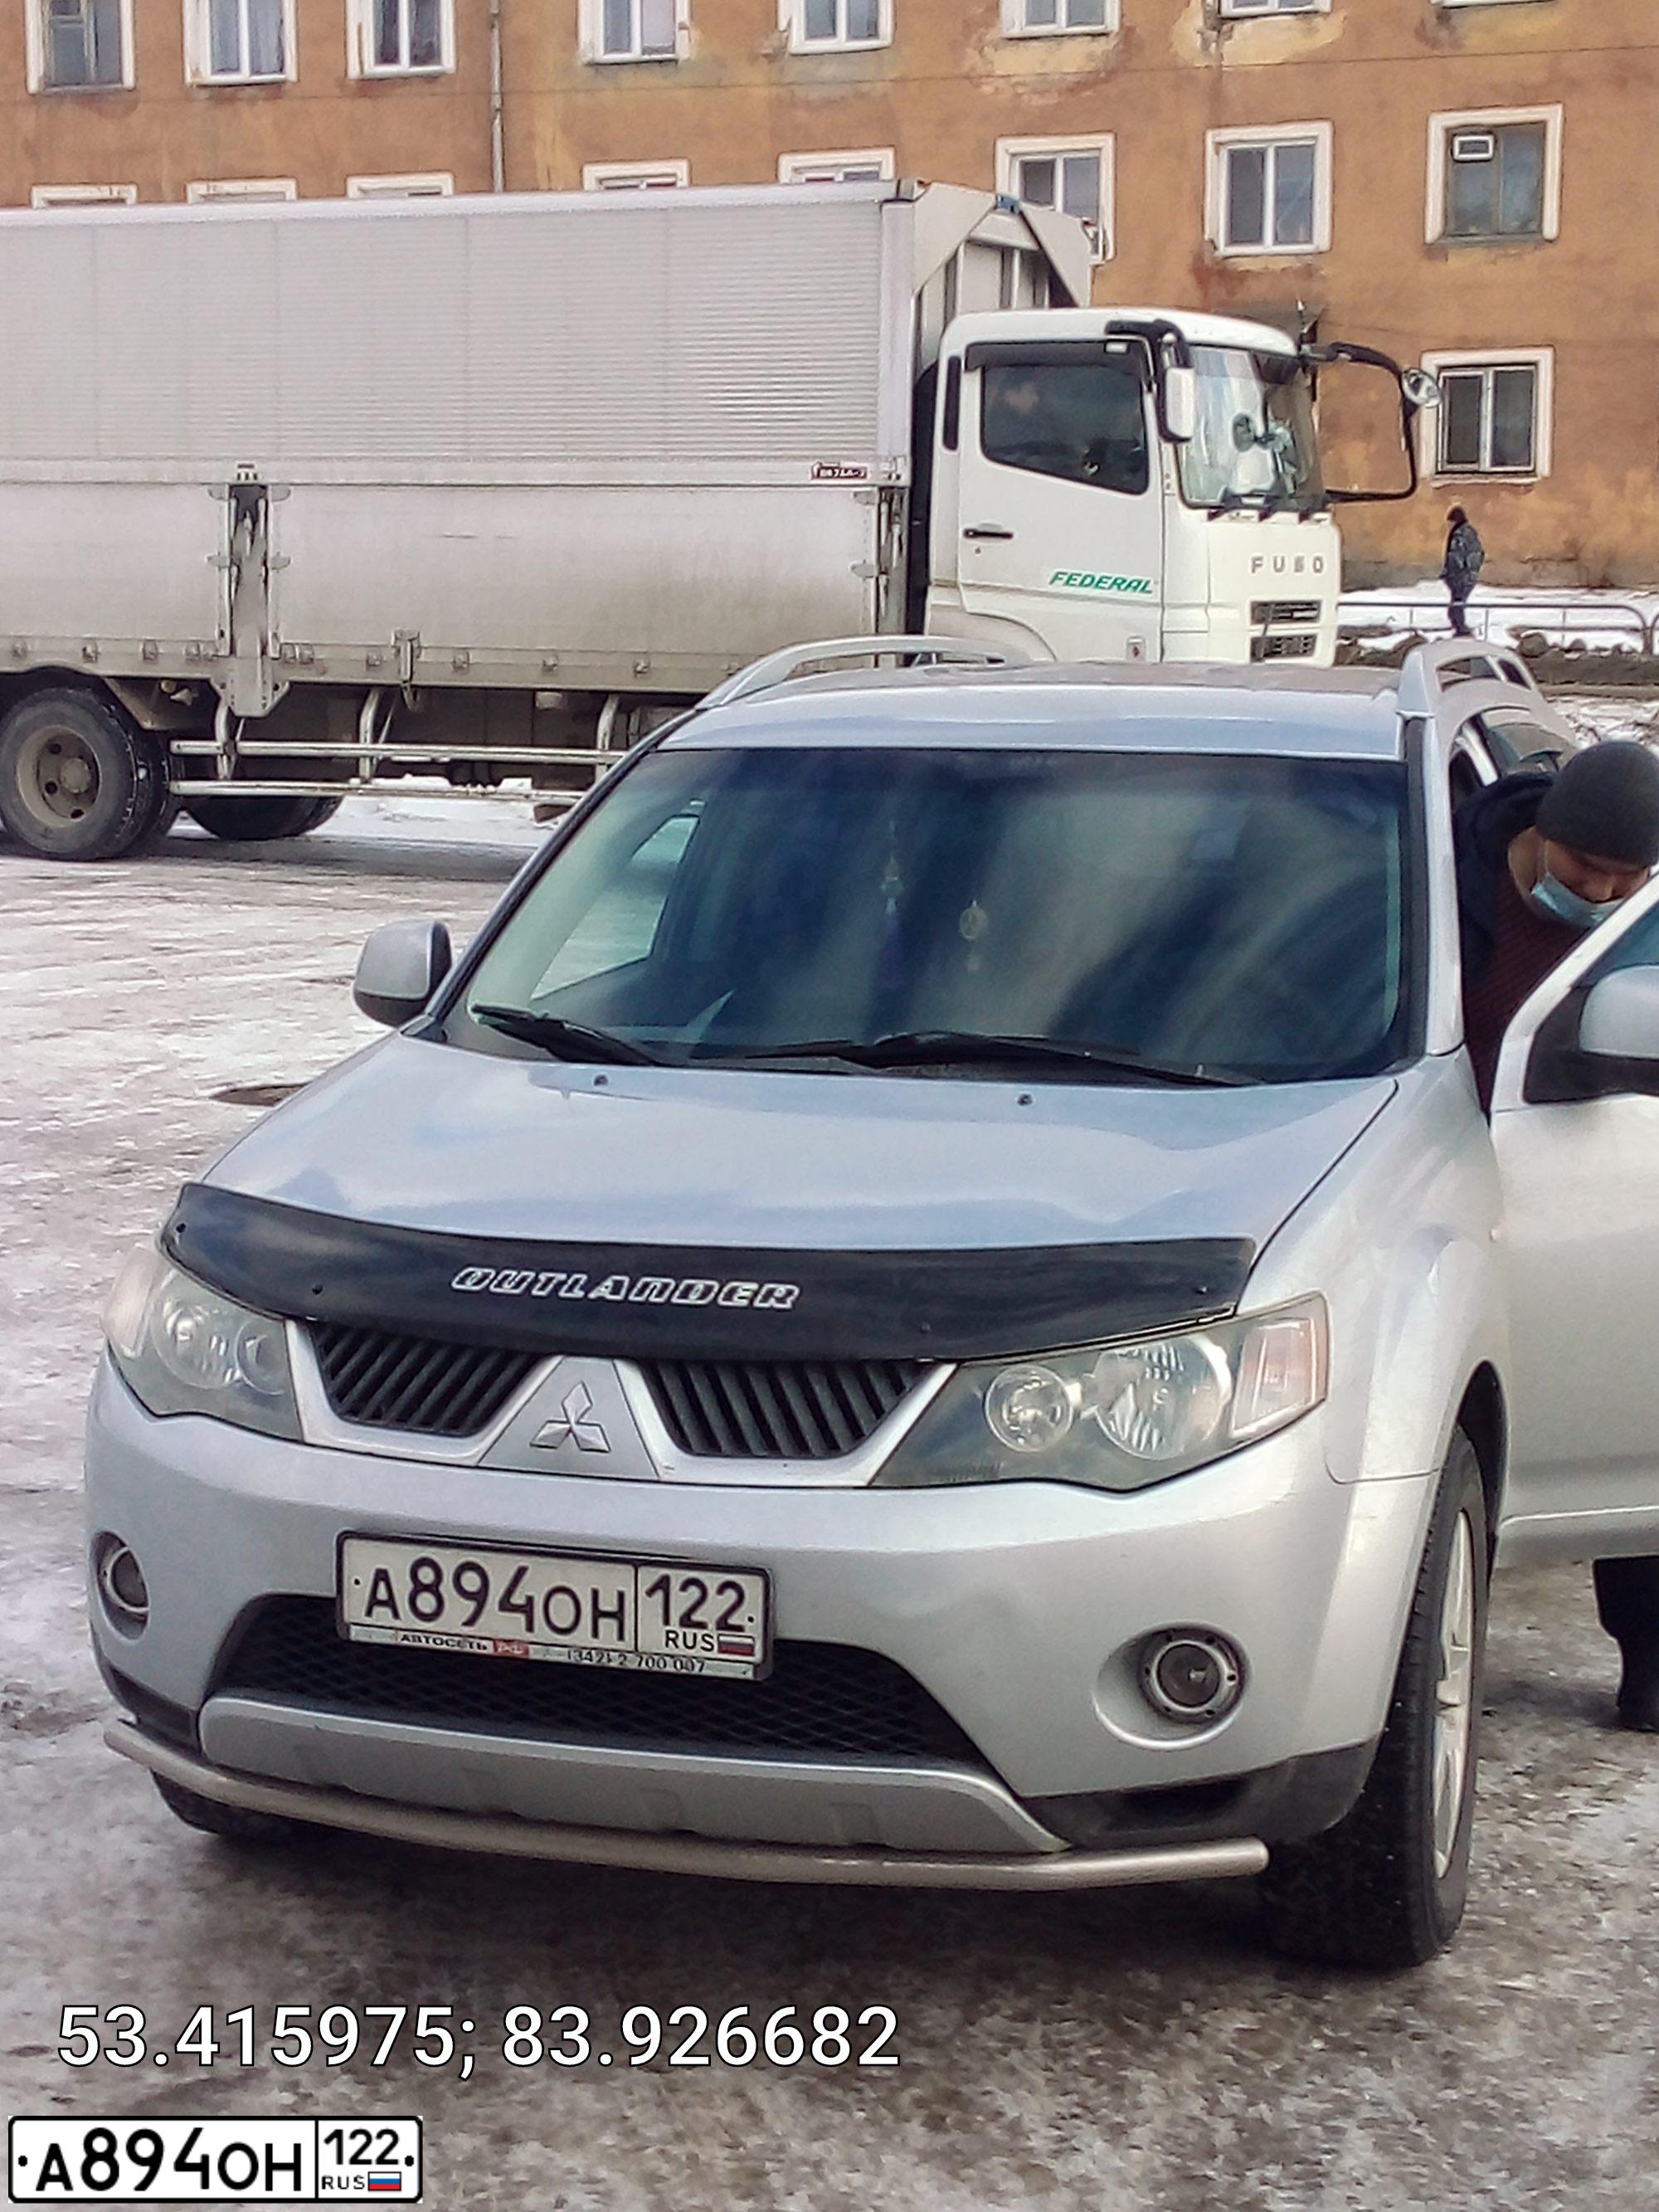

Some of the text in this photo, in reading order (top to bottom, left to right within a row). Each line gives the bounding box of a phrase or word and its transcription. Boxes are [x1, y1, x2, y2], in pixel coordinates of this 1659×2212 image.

[1048, 571, 1153, 594] FEDERAL
[450, 1267, 800, 1309] OUTLANDER
[645, 1573, 746, 1633] 122
[400, 1633, 488, 1651] АВТОСЕТЬ
[664, 1629, 715, 1653] RUS
